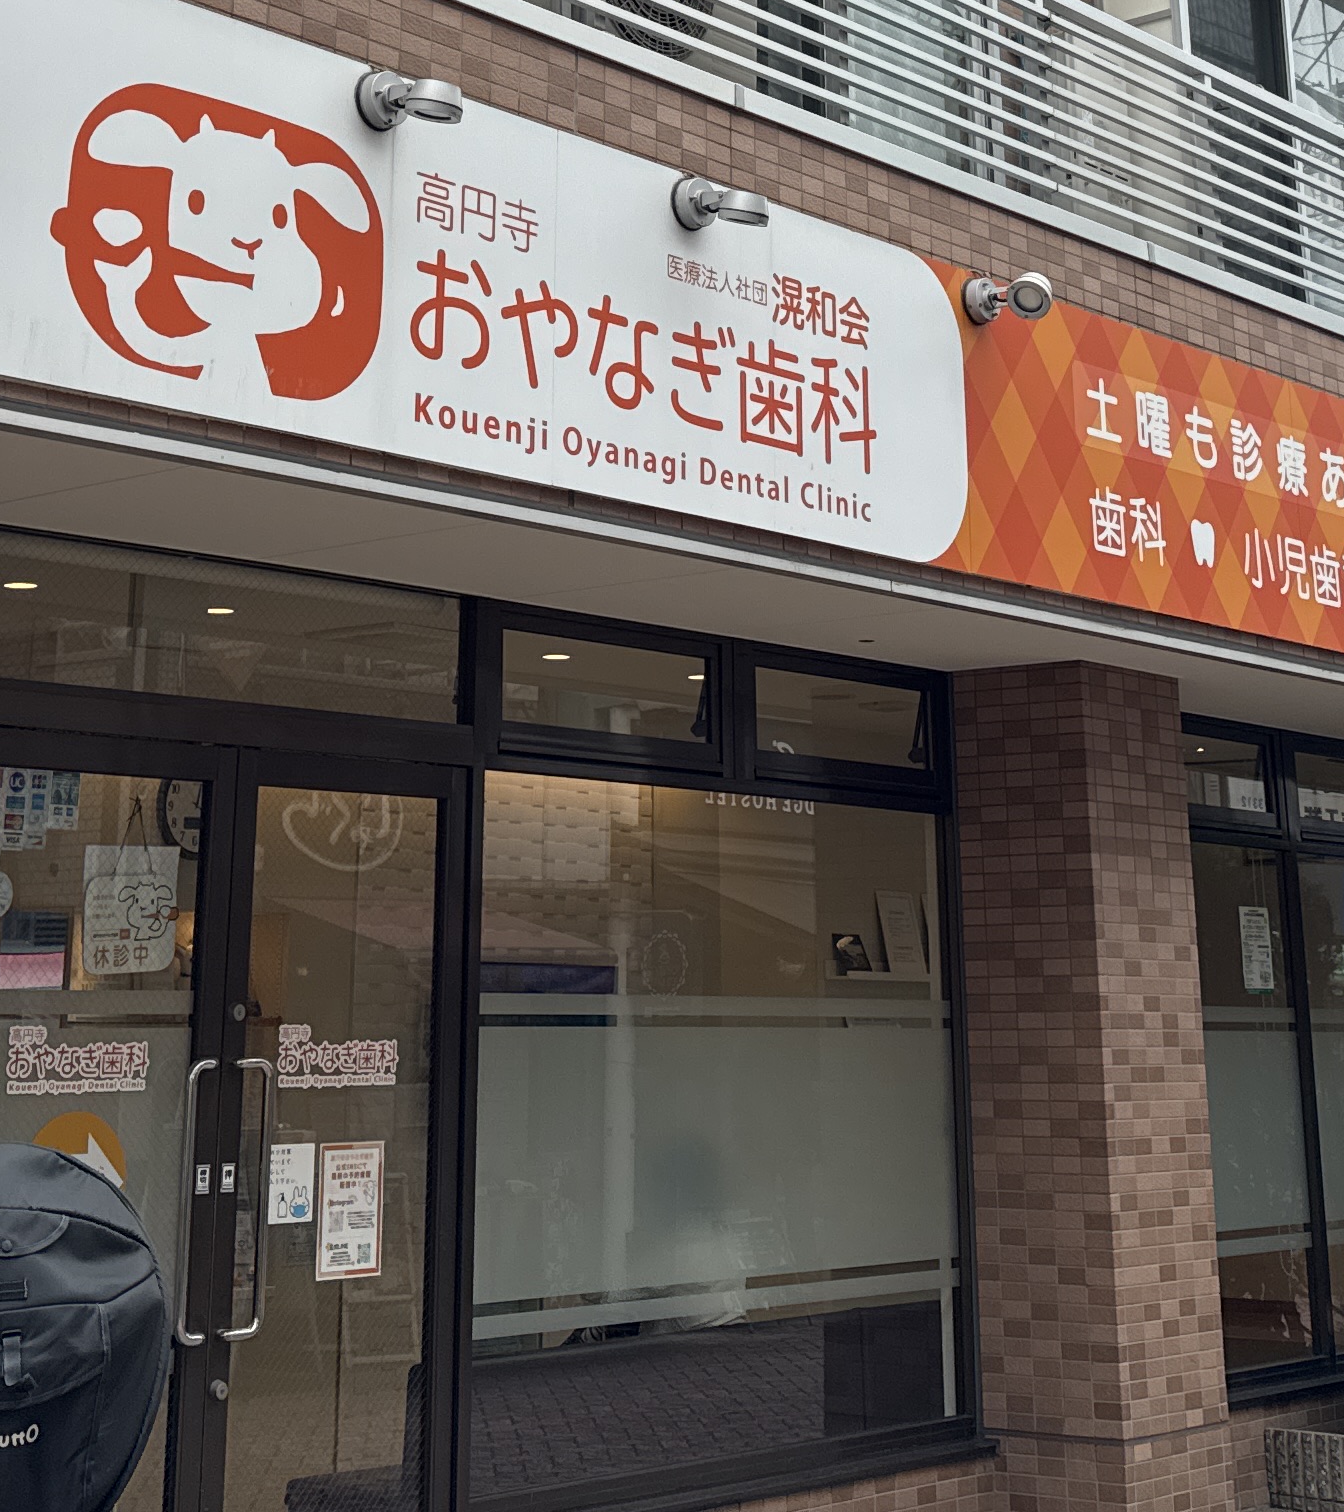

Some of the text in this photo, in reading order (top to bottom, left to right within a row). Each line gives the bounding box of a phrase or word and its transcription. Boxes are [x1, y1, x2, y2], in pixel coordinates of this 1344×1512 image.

[416, 171, 539, 253] 高円寺
[667, 253, 870, 350] 医療法人社団 滉和会
[410, 248, 877, 475] おやなぎ歯科
[414, 392, 872, 523] Kouenji Oyanagi Dental Clinic
[1088, 486, 1167, 566] 歯科
[93, 943, 149, 969] 休診中
[8, 1043, 149, 1076] おやなぎ歯科
[11, 1028, 46, 1043] 高円寺
[279, 1042, 397, 1071] おやなぎ歯科
[8, 1079, 144, 1092] Kouenji Oyanagi Dental Clinic
